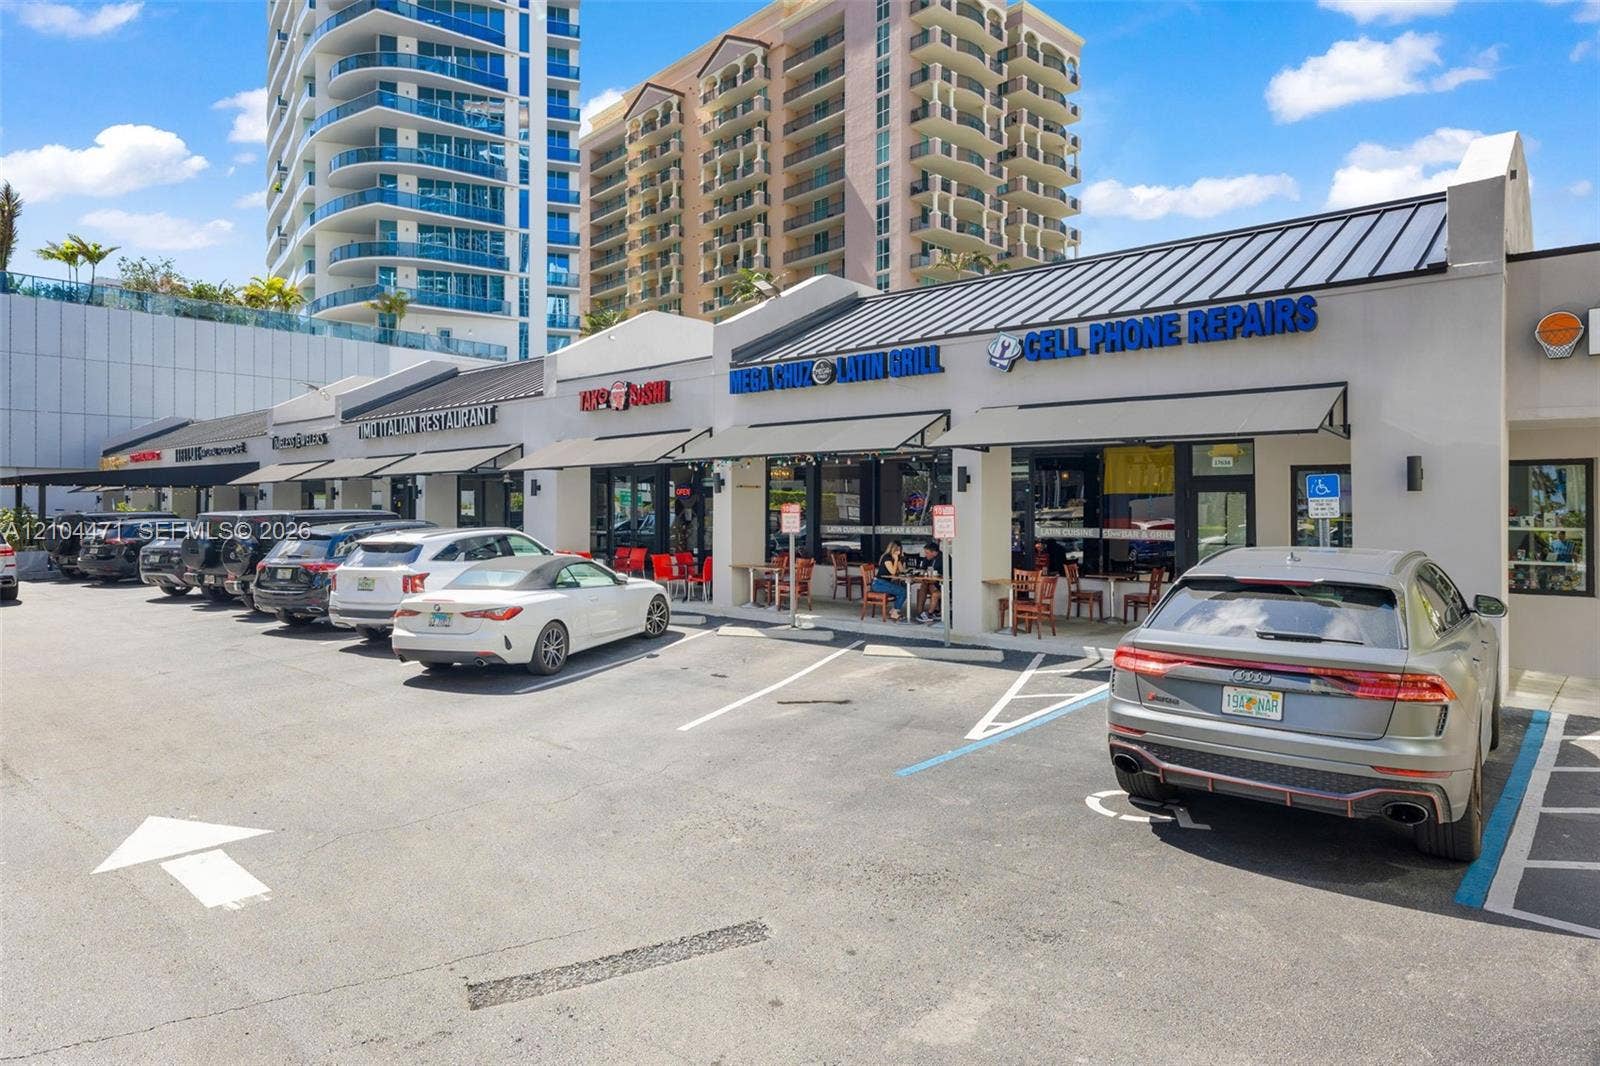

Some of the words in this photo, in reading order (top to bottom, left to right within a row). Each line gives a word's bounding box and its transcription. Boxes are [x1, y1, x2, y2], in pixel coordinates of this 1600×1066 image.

[1023, 327, 1084, 361] CELL
[1089, 313, 1181, 354] PHONE
[1188, 295, 1318, 343] REPAIRS
[729, 367, 771, 394] MEGA
[773, 360, 815, 390] CHUZ
[836, 352, 887, 383] LATIN
[889, 345, 944, 378] GRILL
[629, 380, 671, 405] SUSHI
[379, 416, 417, 437] ITALIAN
[419, 405, 497, 432] RESTAURANT
[676, 488, 690, 496] OPEN
[1040, 528, 1061, 536] LATIN
[1062, 529, 1093, 537] CUISINE
[1121, 529, 1138, 538] BAR
[1150, 530, 1175, 539] GRILL
[1257, 698, 1279, 712] NAR
